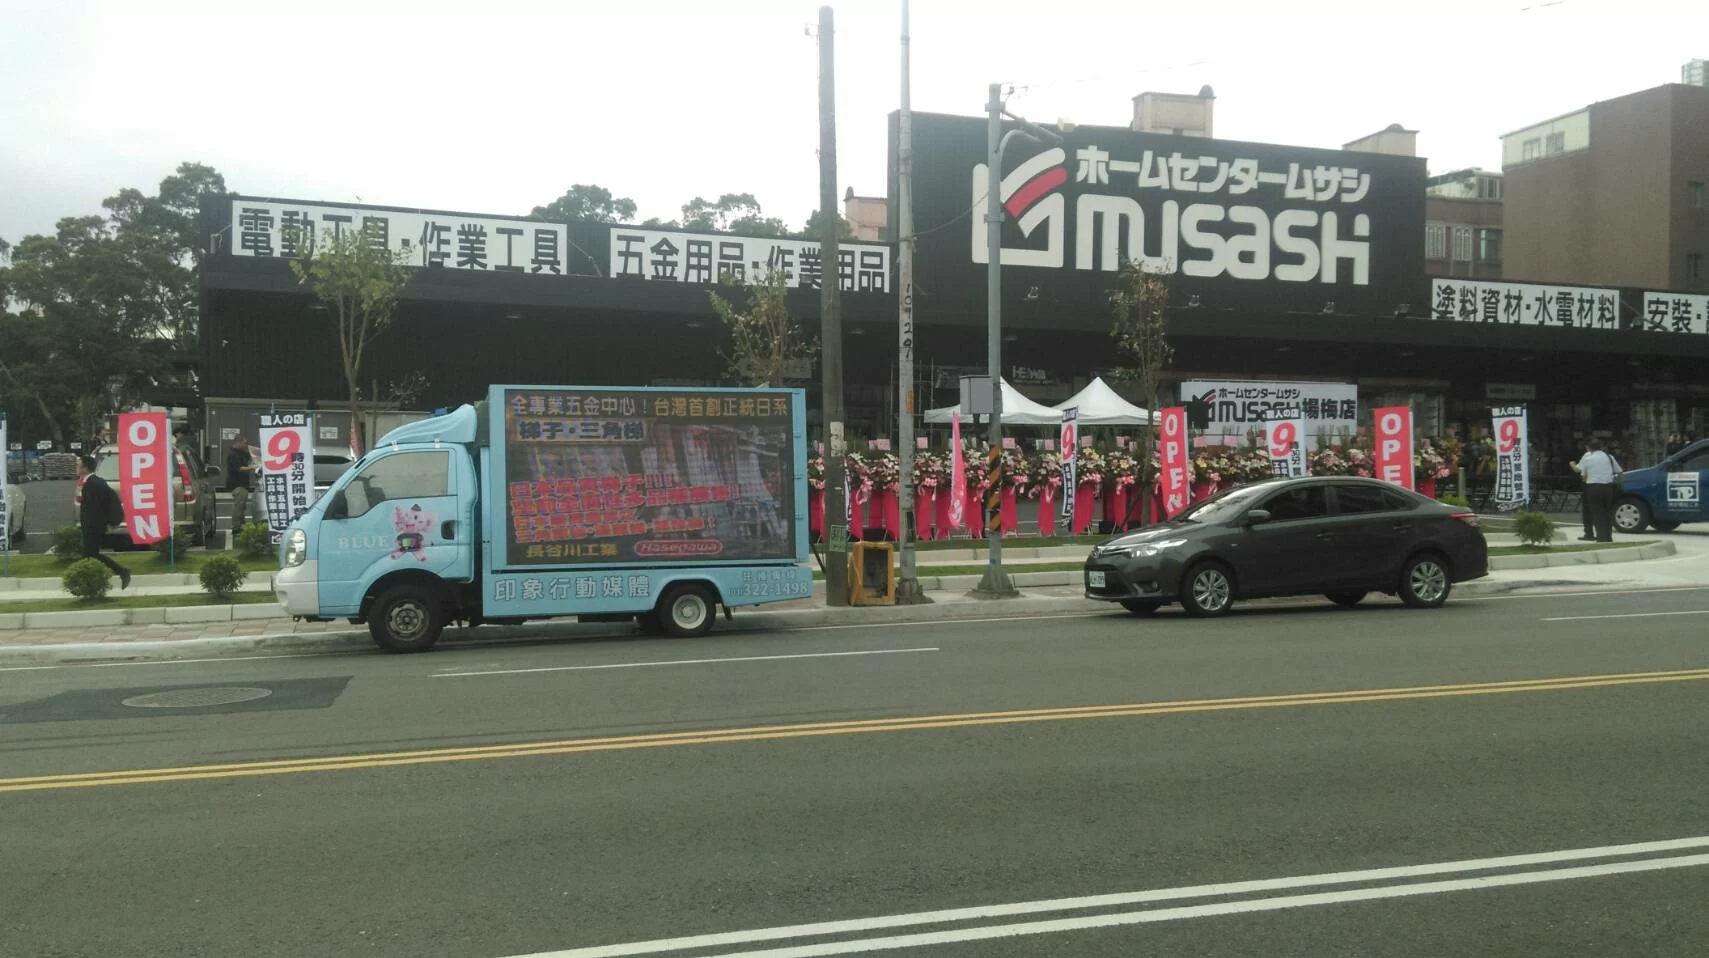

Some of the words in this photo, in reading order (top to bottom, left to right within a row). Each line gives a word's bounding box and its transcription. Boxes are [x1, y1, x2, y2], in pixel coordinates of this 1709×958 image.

[1075, 145, 1371, 203] ホームセンタームサシ
[1647, 297, 1709, 334] 安裝·
[1218, 387, 1301, 400] ホームセンタームサシ
[128, 420, 161, 541] OPEN
[1165, 414, 1184, 513] OPEN
[337, 535, 390, 550] BLUE
[494, 575, 650, 601] 印象行動媒體
